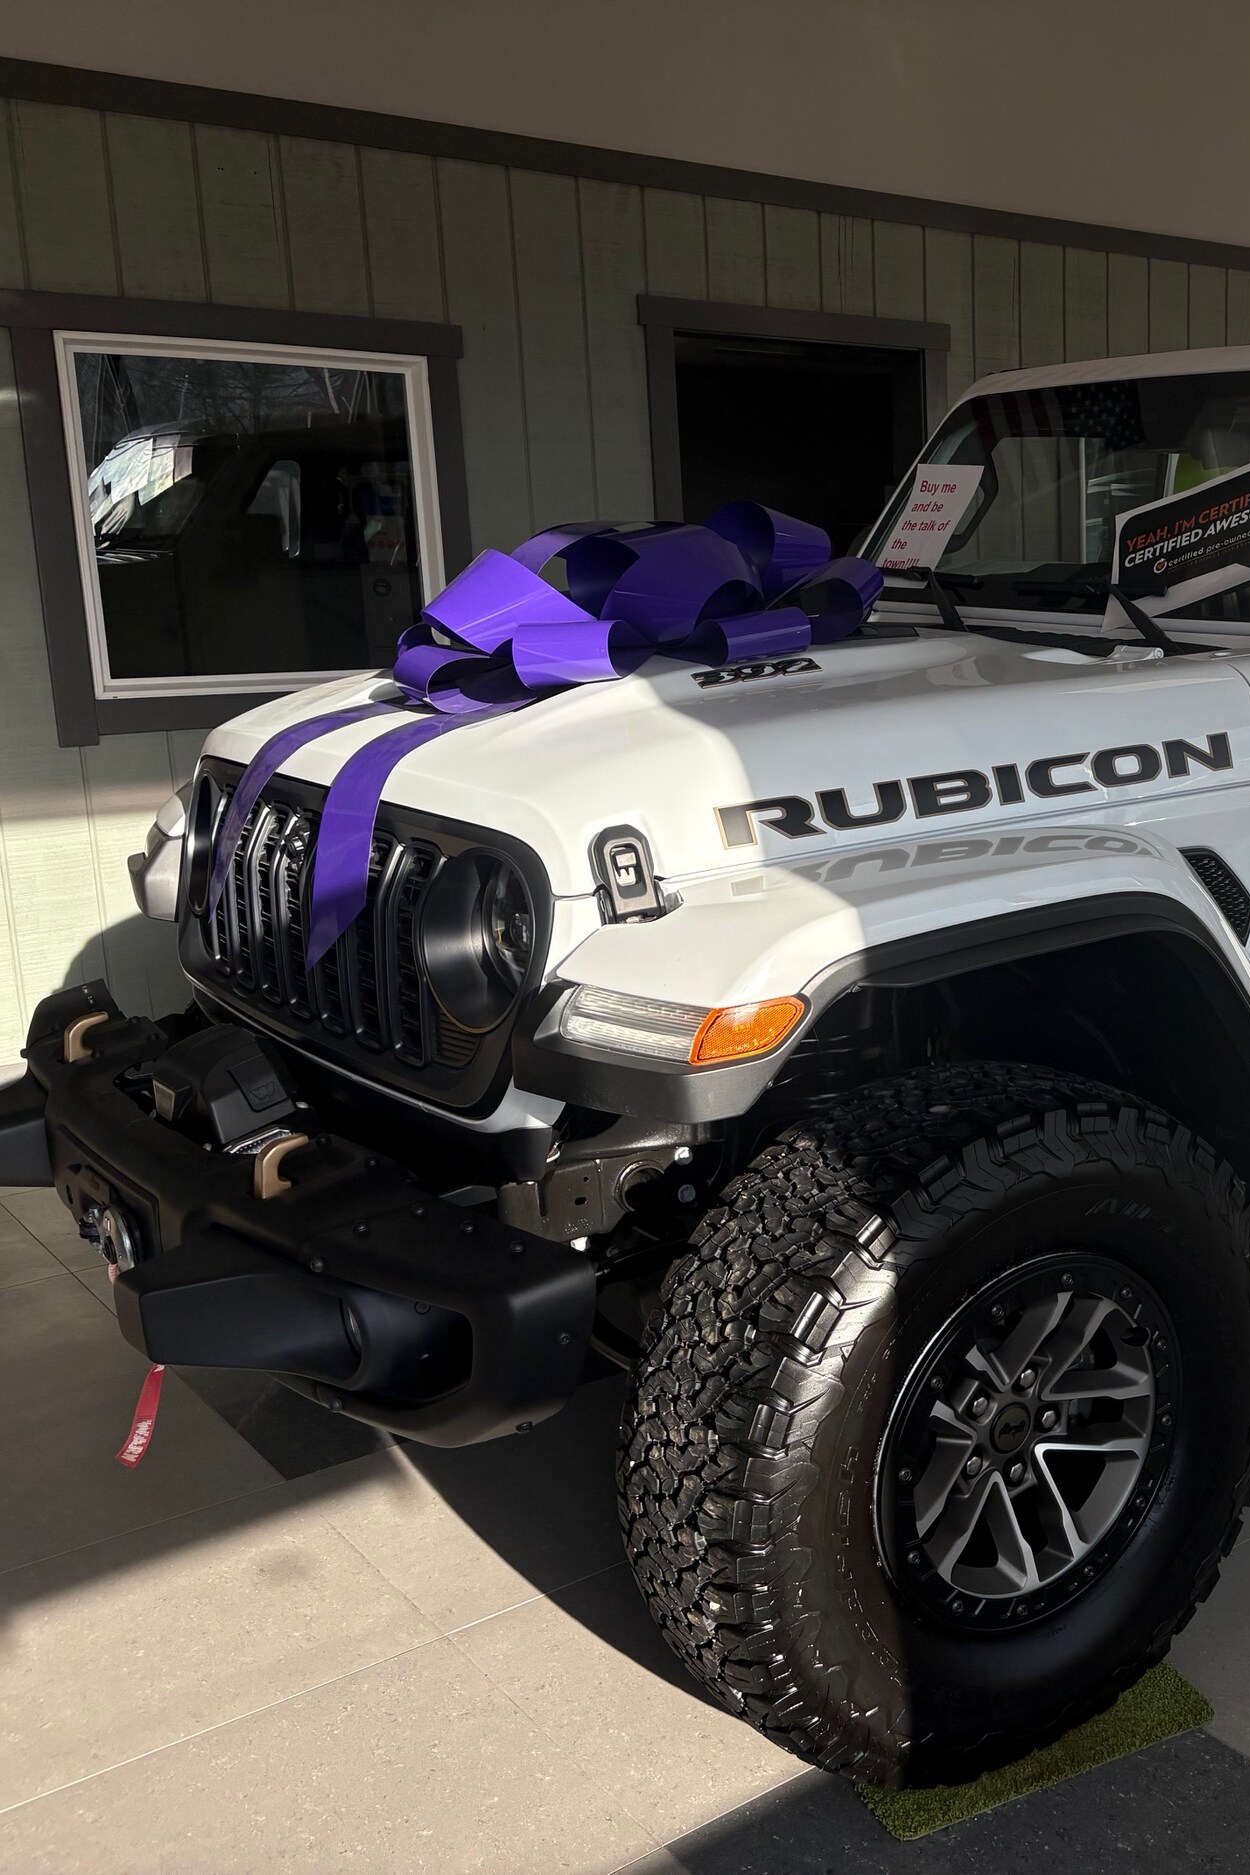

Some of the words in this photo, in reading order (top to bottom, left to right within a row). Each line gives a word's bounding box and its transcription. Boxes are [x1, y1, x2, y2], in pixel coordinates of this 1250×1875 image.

[919, 480, 940, 496] Buy
[941, 483, 957, 493] me
[911, 501, 932, 512] and
[931, 501, 944, 513] be
[901, 520, 918, 531] the
[918, 520, 937, 531] talk
[937, 520, 951, 531] of
[1126, 526, 1170, 552] YEAH.
[1174, 515, 1196, 533] I'M
[891, 538, 908, 550] the
[1124, 528, 1203, 568] CERTIFIED
[1168, 547, 1204, 566] certified
[690, 658, 823, 689] 392
[713, 731, 1234, 850] RUBICON
